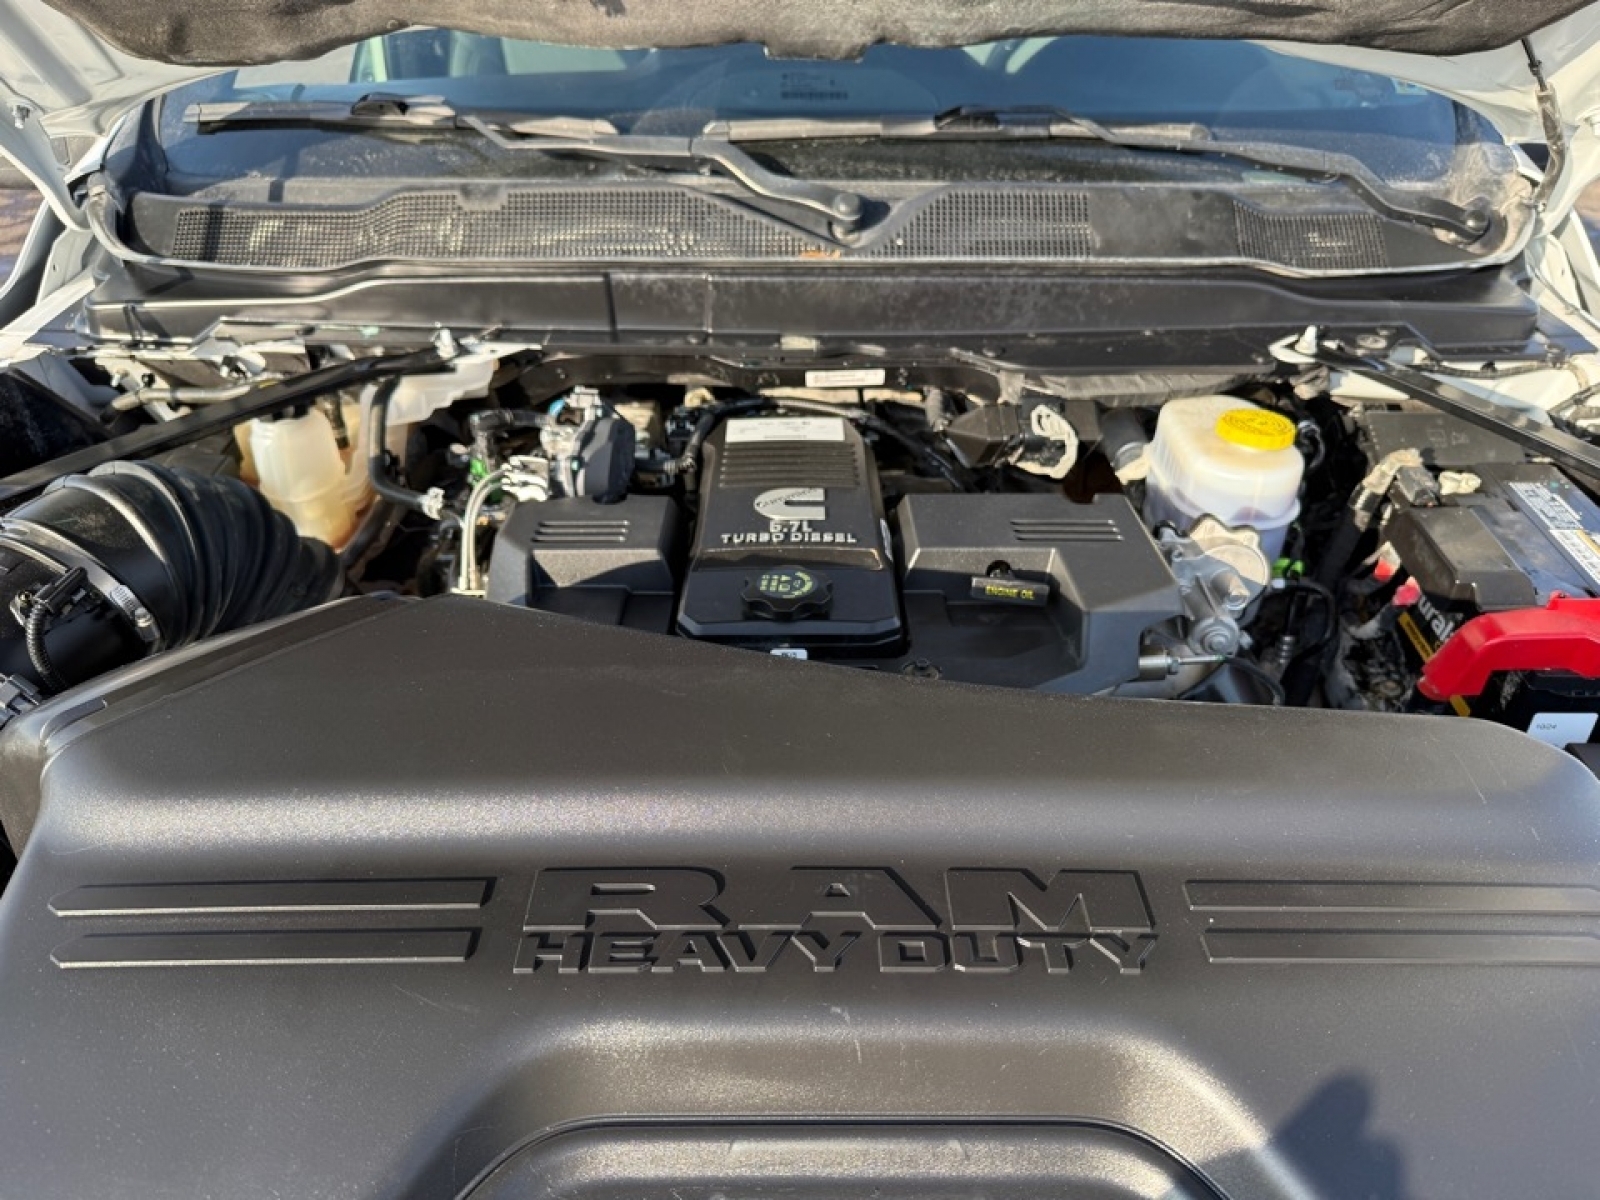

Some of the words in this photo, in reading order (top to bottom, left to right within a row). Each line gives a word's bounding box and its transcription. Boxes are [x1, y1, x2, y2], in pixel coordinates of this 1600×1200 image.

[721, 532, 784, 544] TURBO
[789, 532, 857, 543] DIESEL
[985, 585, 1019, 598] ENGINE
[1021, 588, 1036, 600] OIL
[522, 866, 1156, 932] RAM
[512, 931, 865, 974] HEAVY
[878, 931, 1159, 974] DUTY
